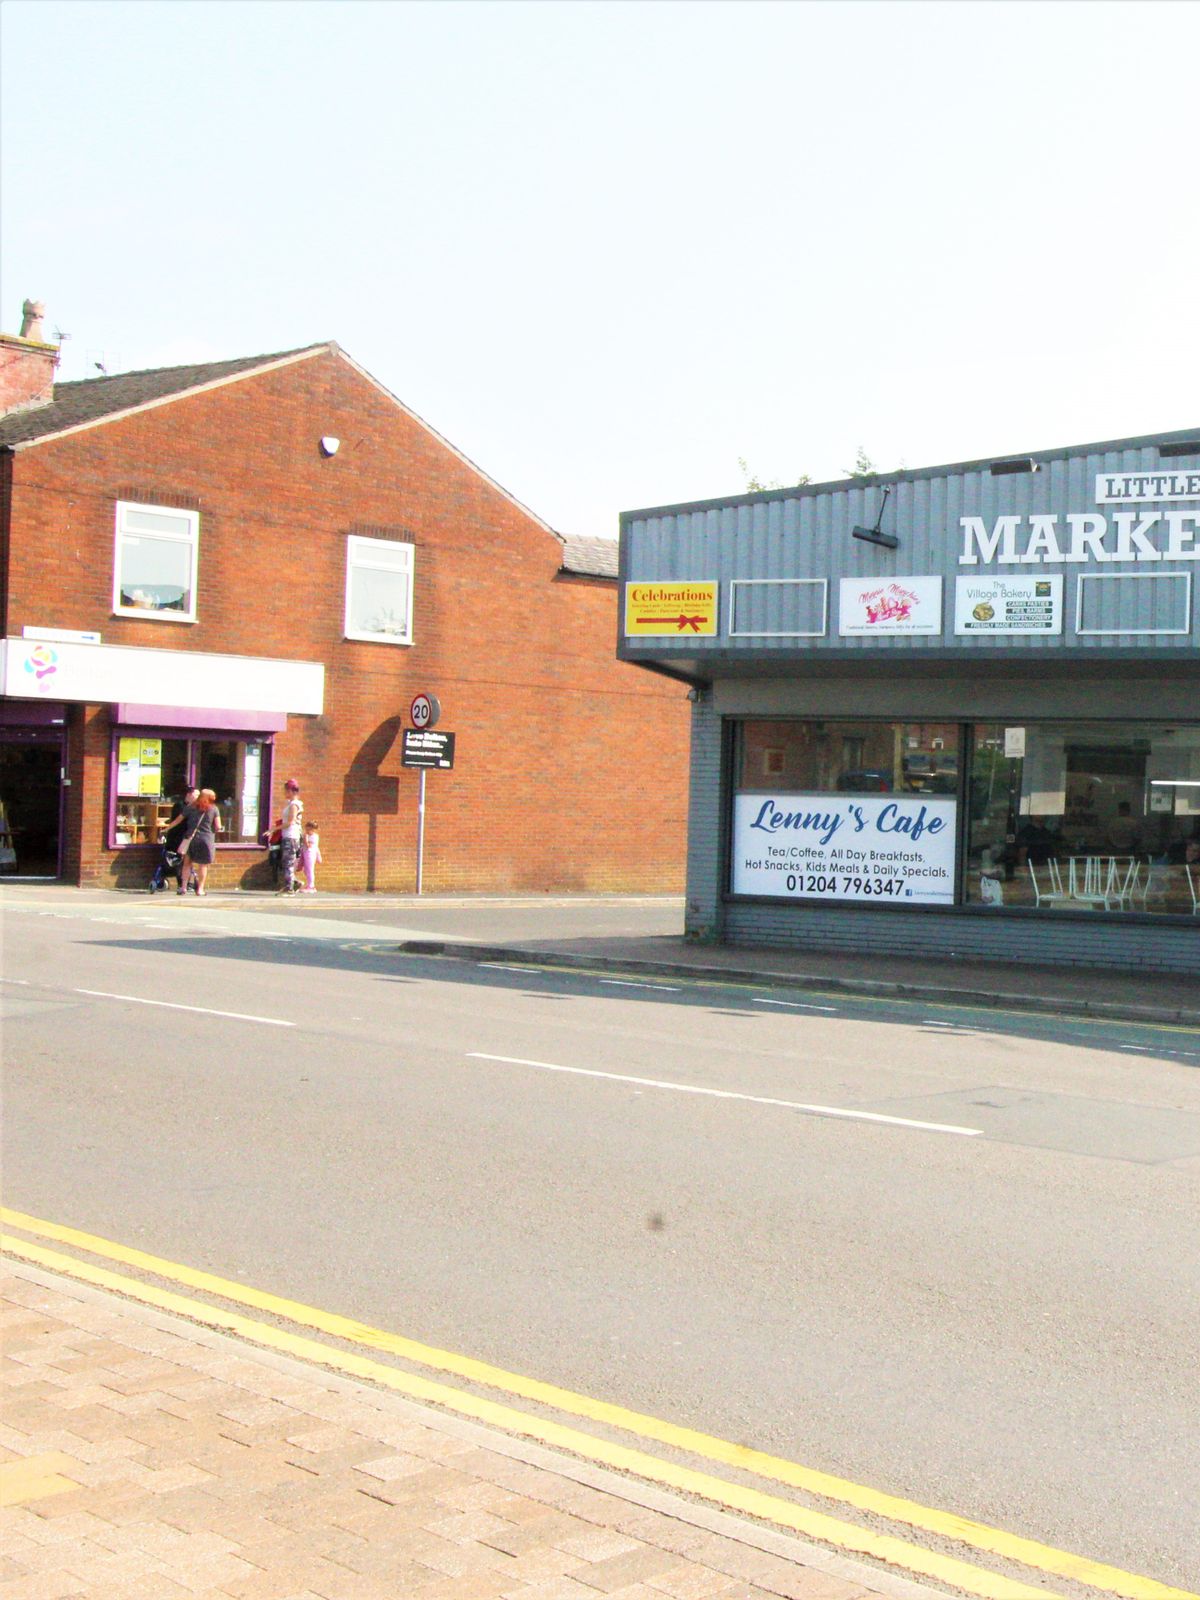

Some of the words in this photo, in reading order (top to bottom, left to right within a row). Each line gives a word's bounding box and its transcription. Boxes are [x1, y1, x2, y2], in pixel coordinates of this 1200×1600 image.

[1105, 474, 1200, 498] LITTLE
[993, 581, 1005, 589] The
[632, 588, 713, 602] Celebrations
[967, 588, 998, 601] Village
[1001, 589, 1032, 600] Bakery
[413, 704, 429, 719] 20
[750, 800, 869, 845] Lenny's
[876, 803, 946, 841] Cafe
[768, 846, 827, 859] Tea/Coffee,
[830, 848, 844, 859] All
[846, 849, 867, 862] Day
[870, 850, 926, 863] Breakfasts,
[745, 859, 762, 870] Hot
[764, 860, 803, 872] Snacks,
[806, 861, 826, 872] Kids
[829, 863, 860, 874] Meals
[863, 864, 870, 874] &
[873, 864, 898, 876] Daily
[902, 866, 950, 878] Specials.
[786, 875, 837, 893] 01204
[843, 877, 904, 895] 796347
